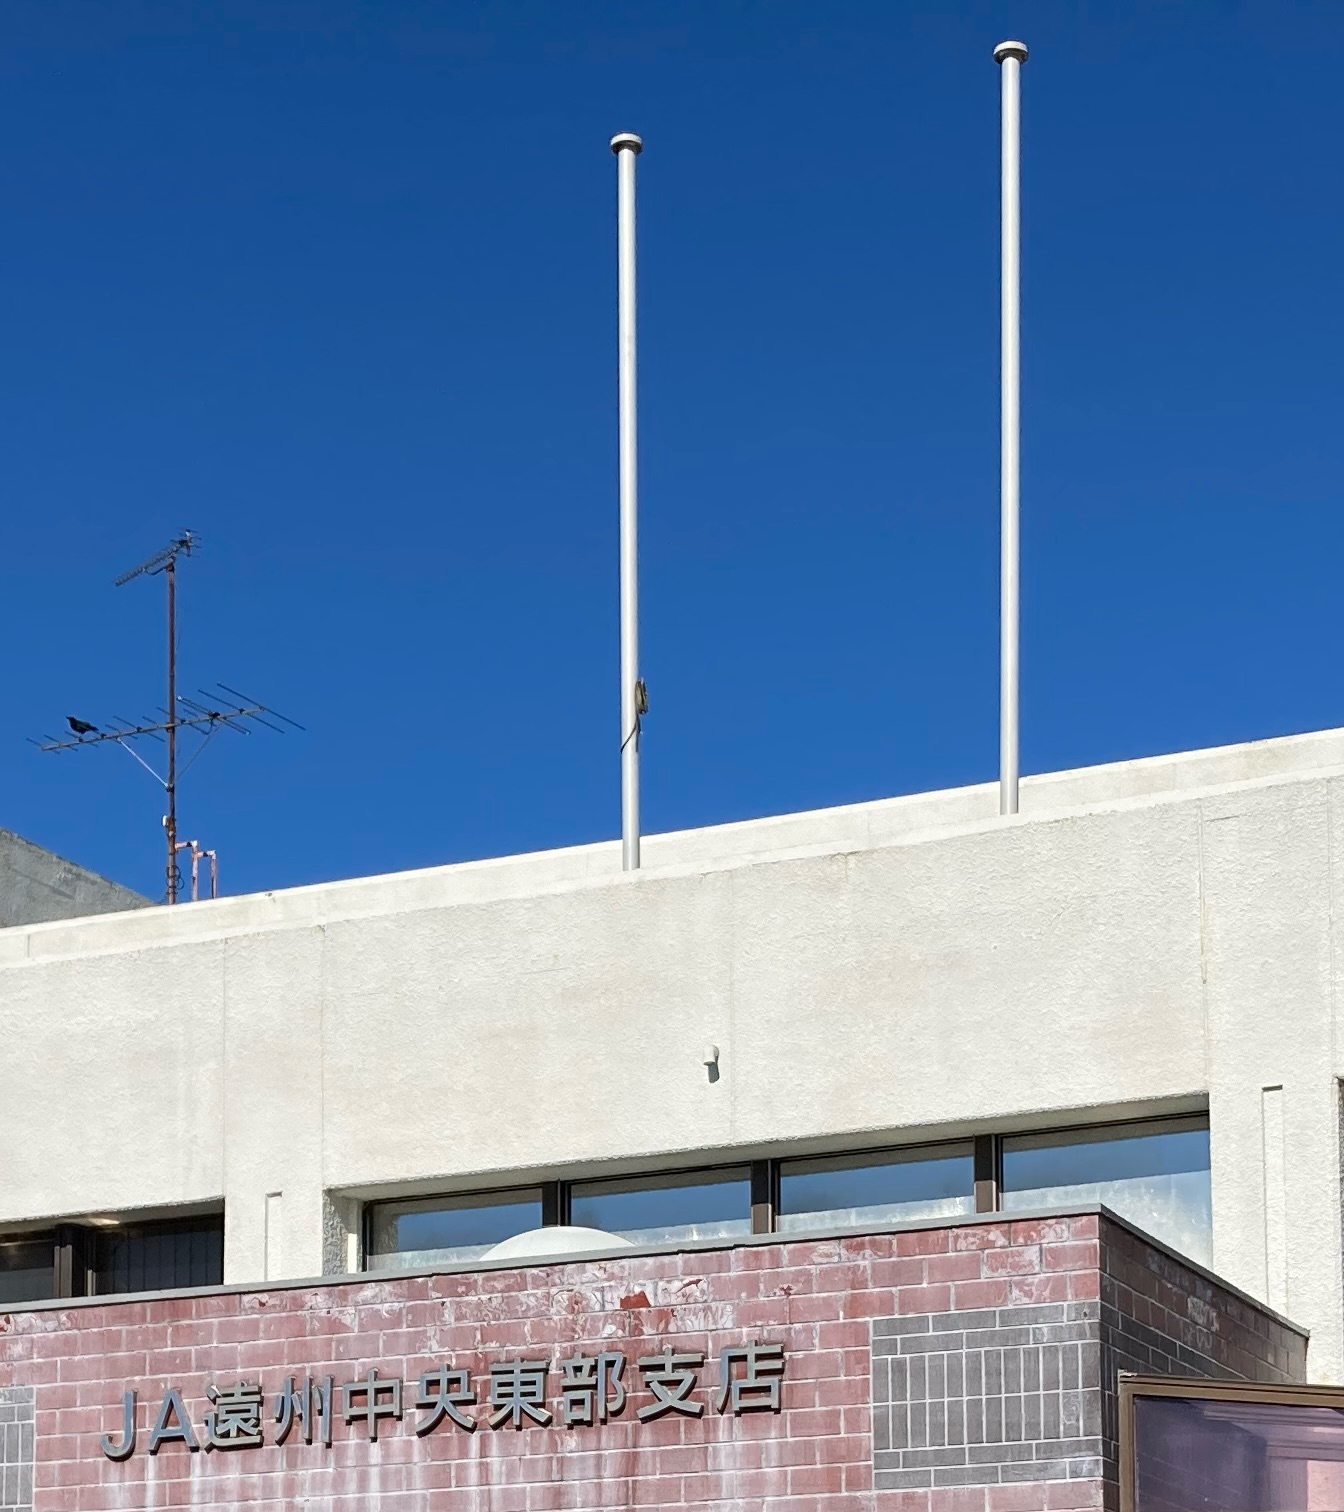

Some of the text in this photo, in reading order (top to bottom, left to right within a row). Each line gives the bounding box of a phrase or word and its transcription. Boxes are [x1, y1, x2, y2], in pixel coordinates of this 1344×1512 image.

[100, 1341, 787, 1462] JA遠州中央東部支店
